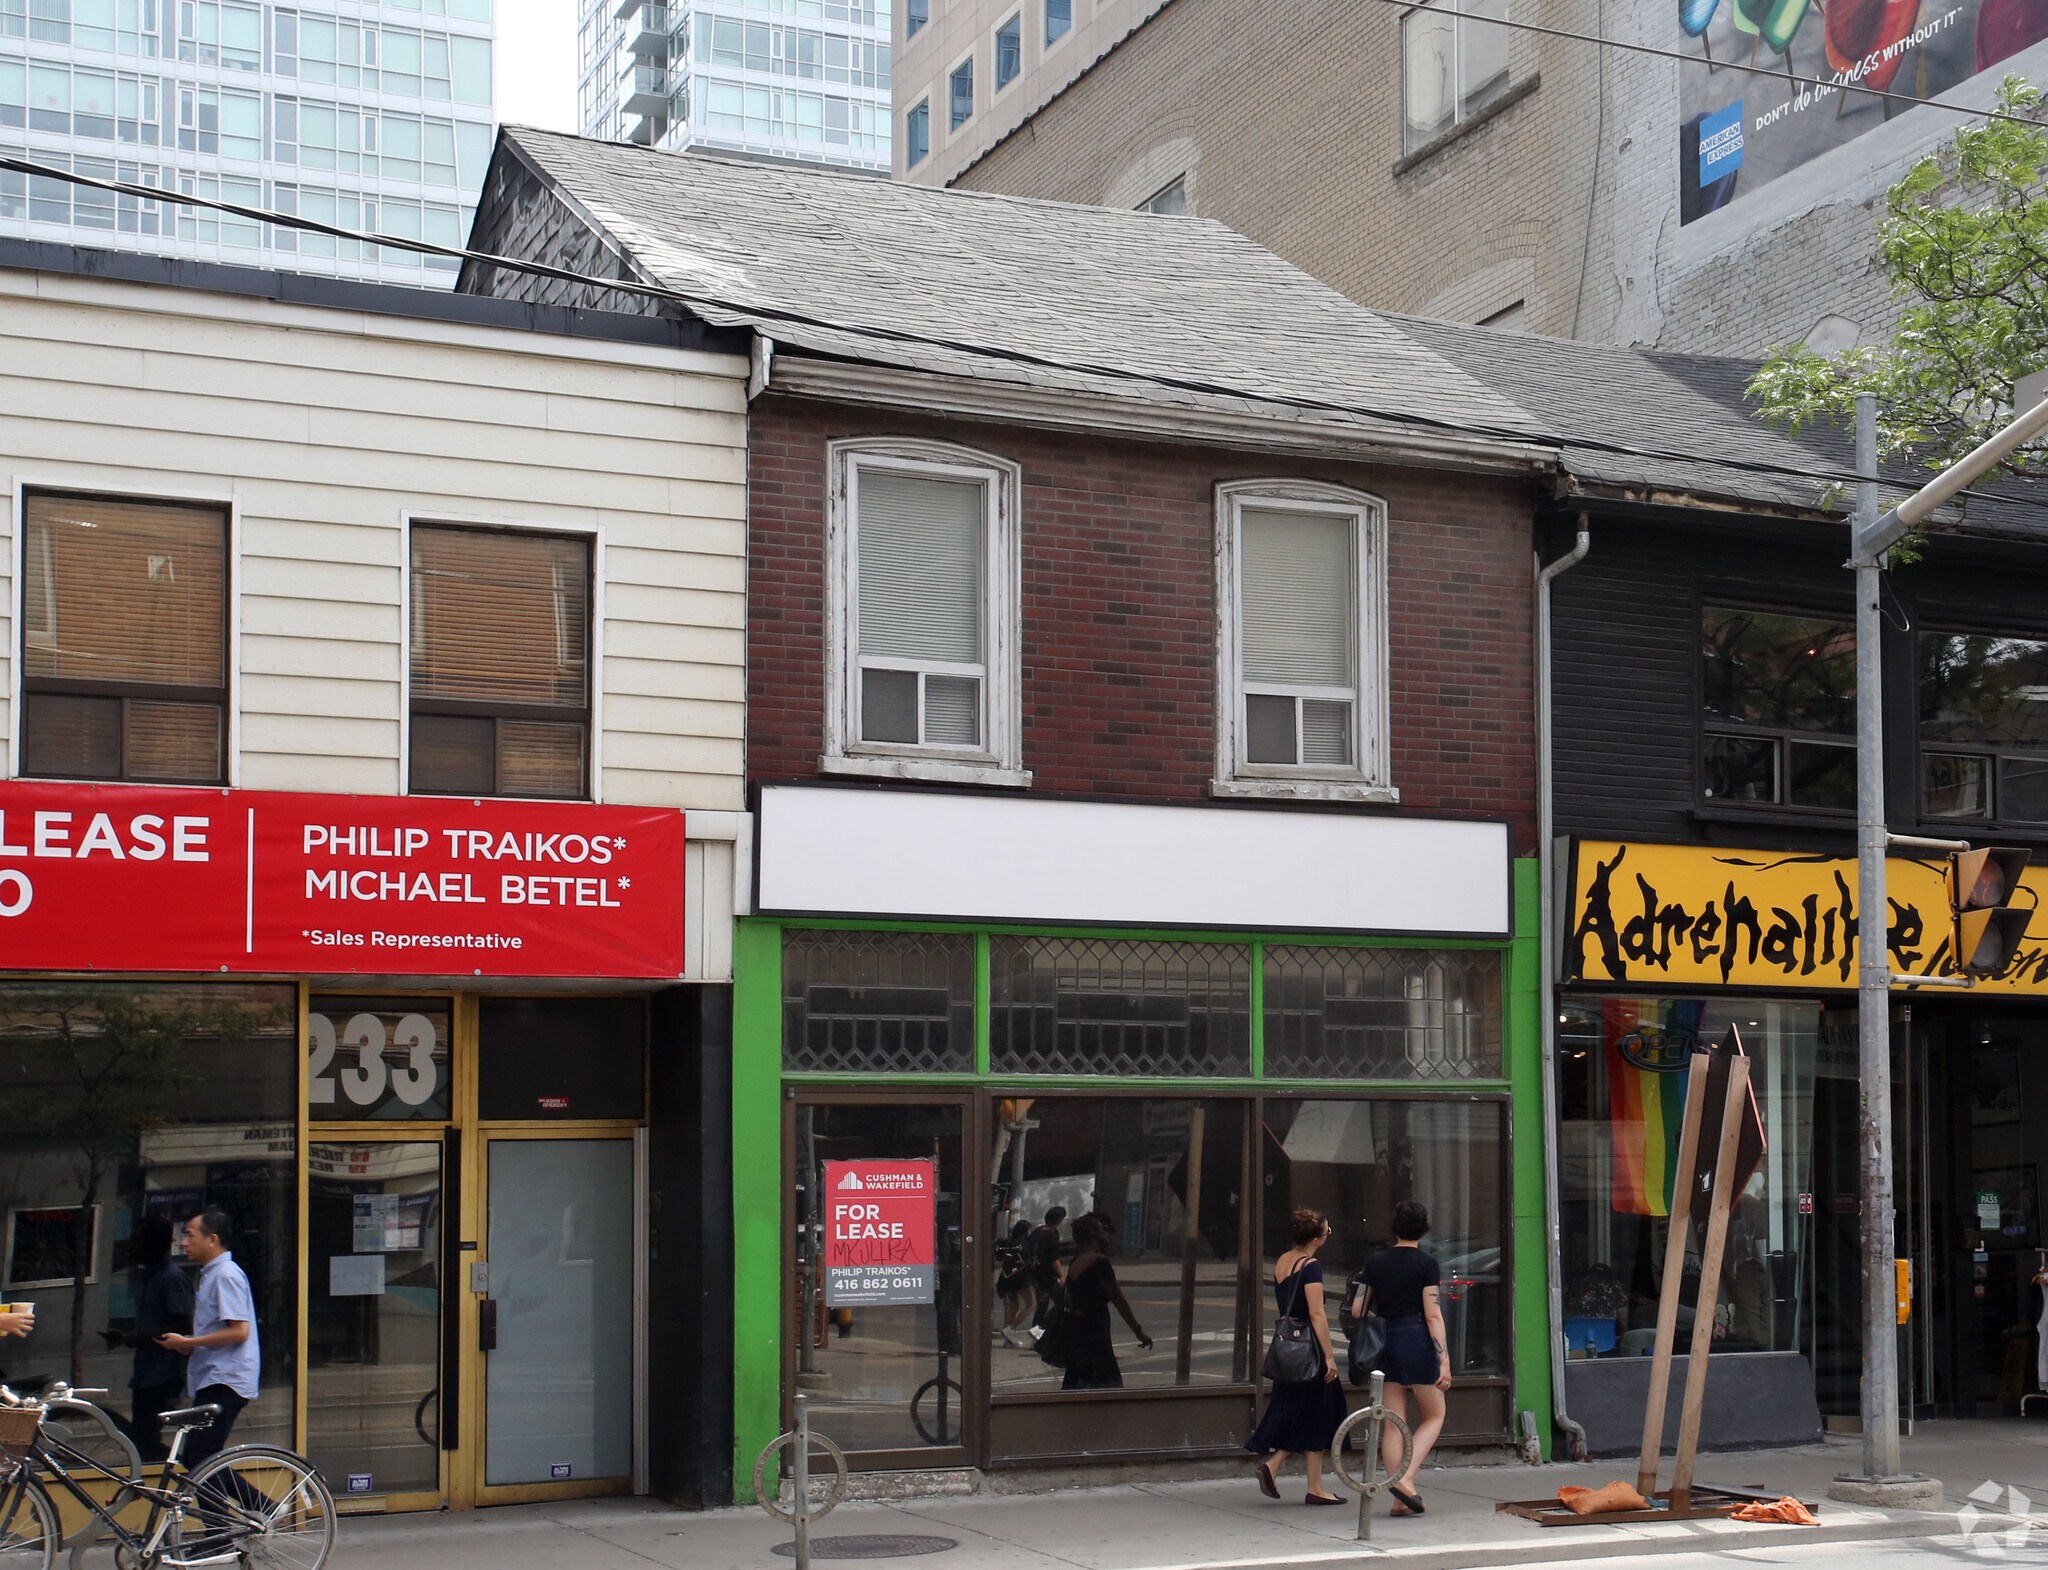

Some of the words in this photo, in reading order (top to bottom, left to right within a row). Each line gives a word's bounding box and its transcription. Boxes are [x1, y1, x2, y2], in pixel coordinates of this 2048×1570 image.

[1755, 101, 1790, 131] DON'T
[1793, 82, 1811, 112] do
[1814, 49, 1880, 102] business
[1882, 19, 1942, 62] WITHOUT
[1699, 121, 1741, 155] AMERICAN
[1707, 136, 1744, 165] EXPRESS
[0, 809, 210, 862] LEASE
[303, 824, 429, 857] PHILIP
[304, 869, 486, 903] MICHAEL
[370, 931, 523, 949] Representative
[308, 1012, 437, 1106] 233
[866, 1174, 914, 1182] CUSHMAN
[916, 1173, 923, 1181] &
[866, 1181, 924, 1190] WAKEFIELD
[1980, 1195, 1998, 1204] PASS
[835, 1204, 880, 1221] FOR
[836, 1223, 904, 1240] LEASE
[832, 1268, 863, 1277] PHILIP
[834, 1279, 859, 1290] 416
[863, 1278, 889, 1289] 862
[892, 1277, 922, 1288] 0611
